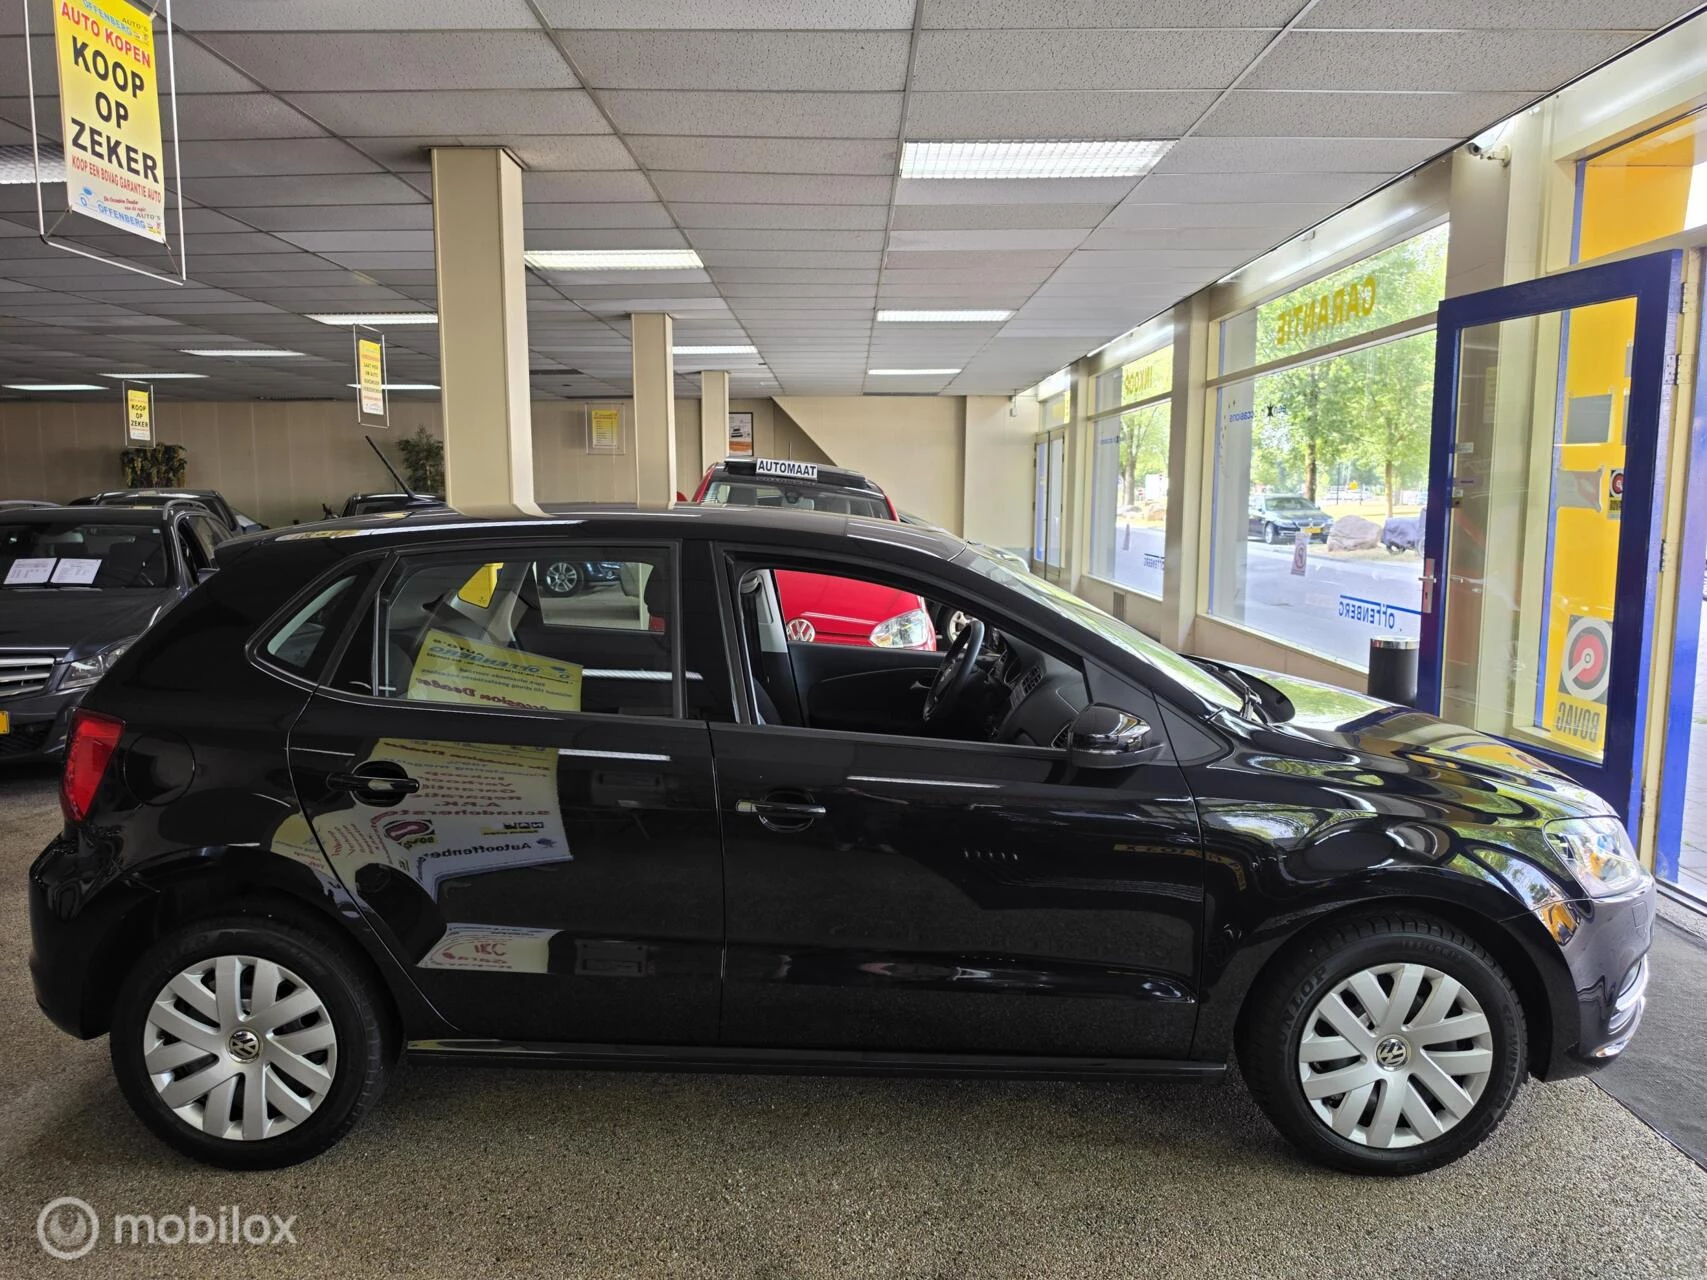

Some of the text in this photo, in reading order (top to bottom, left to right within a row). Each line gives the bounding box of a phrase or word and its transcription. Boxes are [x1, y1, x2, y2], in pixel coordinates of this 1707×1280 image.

[62, 2, 150, 68] AUTO KOPEN
[72, 35, 145, 98] KOOP
[96, 91, 129, 129] OP
[71, 118, 160, 184] ZEKER
[72, 154, 161, 204] KOOP EEN BOVAG GARANTIE AUTO
[98, 203, 146, 229] OFFENBERG
[758, 460, 816, 476] AUTOMAAT
